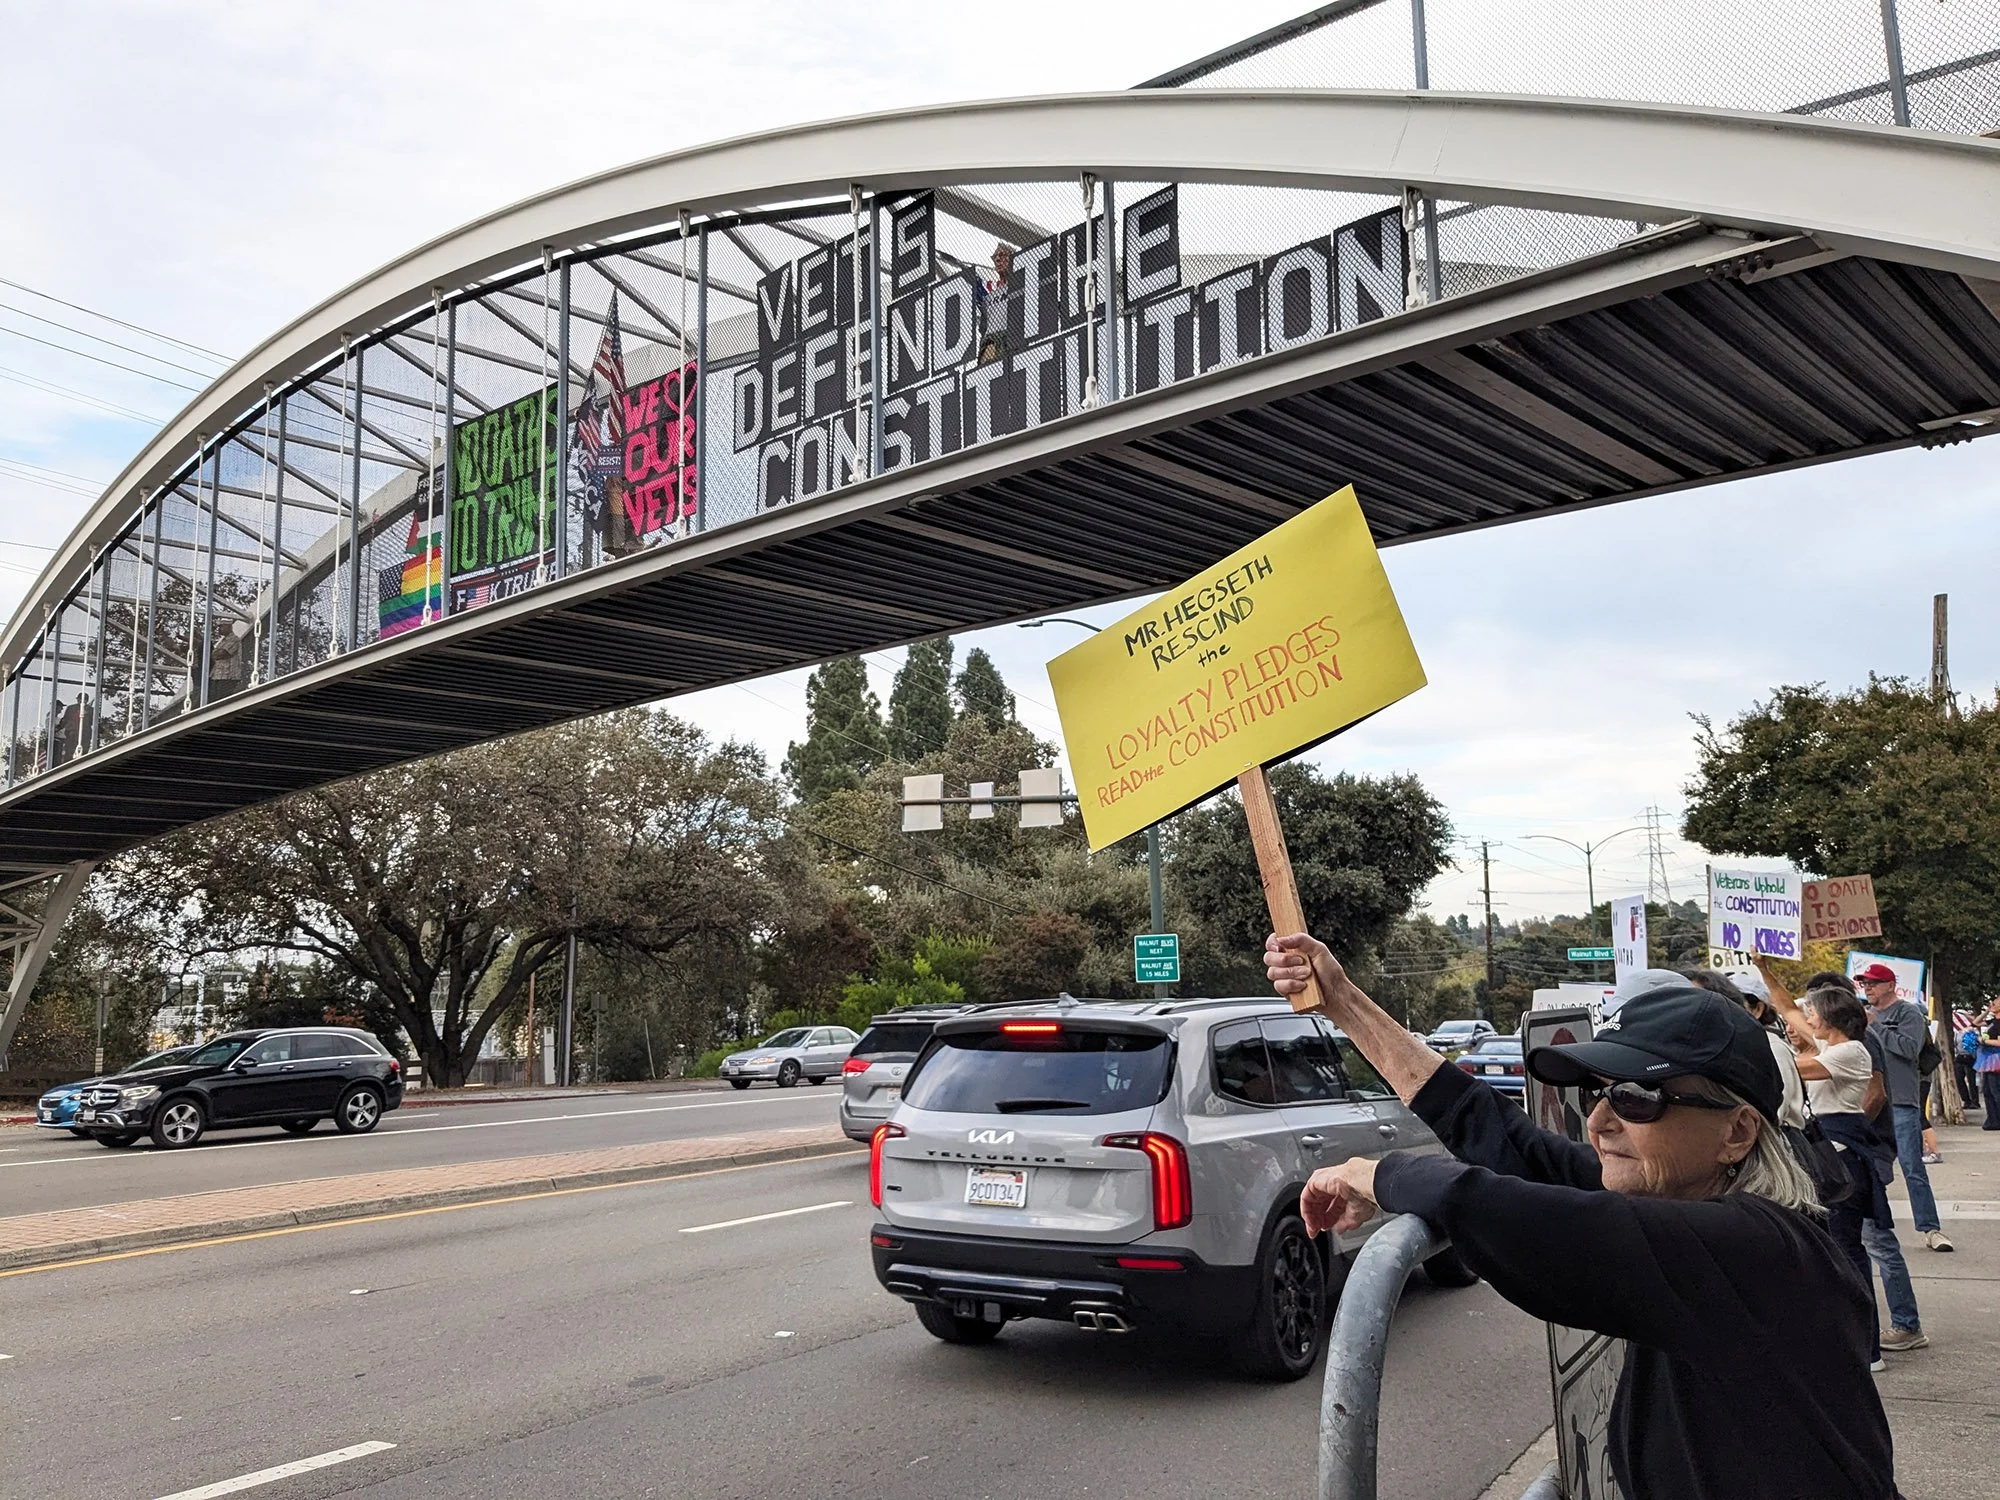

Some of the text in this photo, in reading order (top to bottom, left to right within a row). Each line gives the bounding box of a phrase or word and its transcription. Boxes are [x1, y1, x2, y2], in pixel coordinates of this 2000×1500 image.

[759, 205, 930, 342] VETS
[734, 189, 1178, 450] DEFEND THE
[623, 382, 662, 434] WE
[624, 414, 697, 483] OUR
[622, 464, 697, 537] VETS
[451, 495, 479, 573] TO
[504, 561, 557, 599] TRUP
[1151, 595, 1254, 672] RESCIND
[1198, 642, 1232, 668] the
[1106, 615, 1341, 770] LOYALTY PLEDGES
[1097, 654, 1344, 808] READ the CONSTITUTION
[1714, 872, 1786, 897] Veterans Uphold
[1804, 878, 1870, 901] O OATH
[1713, 895, 1800, 918] the CONSTITUTION
[1811, 901, 1841, 919] TO
[1722, 922, 1741, 949] NO
[1803, 915, 1879, 940] LDEMORT
[967, 1128, 1016, 1144] KIA
[926, 1150, 1066, 1163] TELLURIDE
